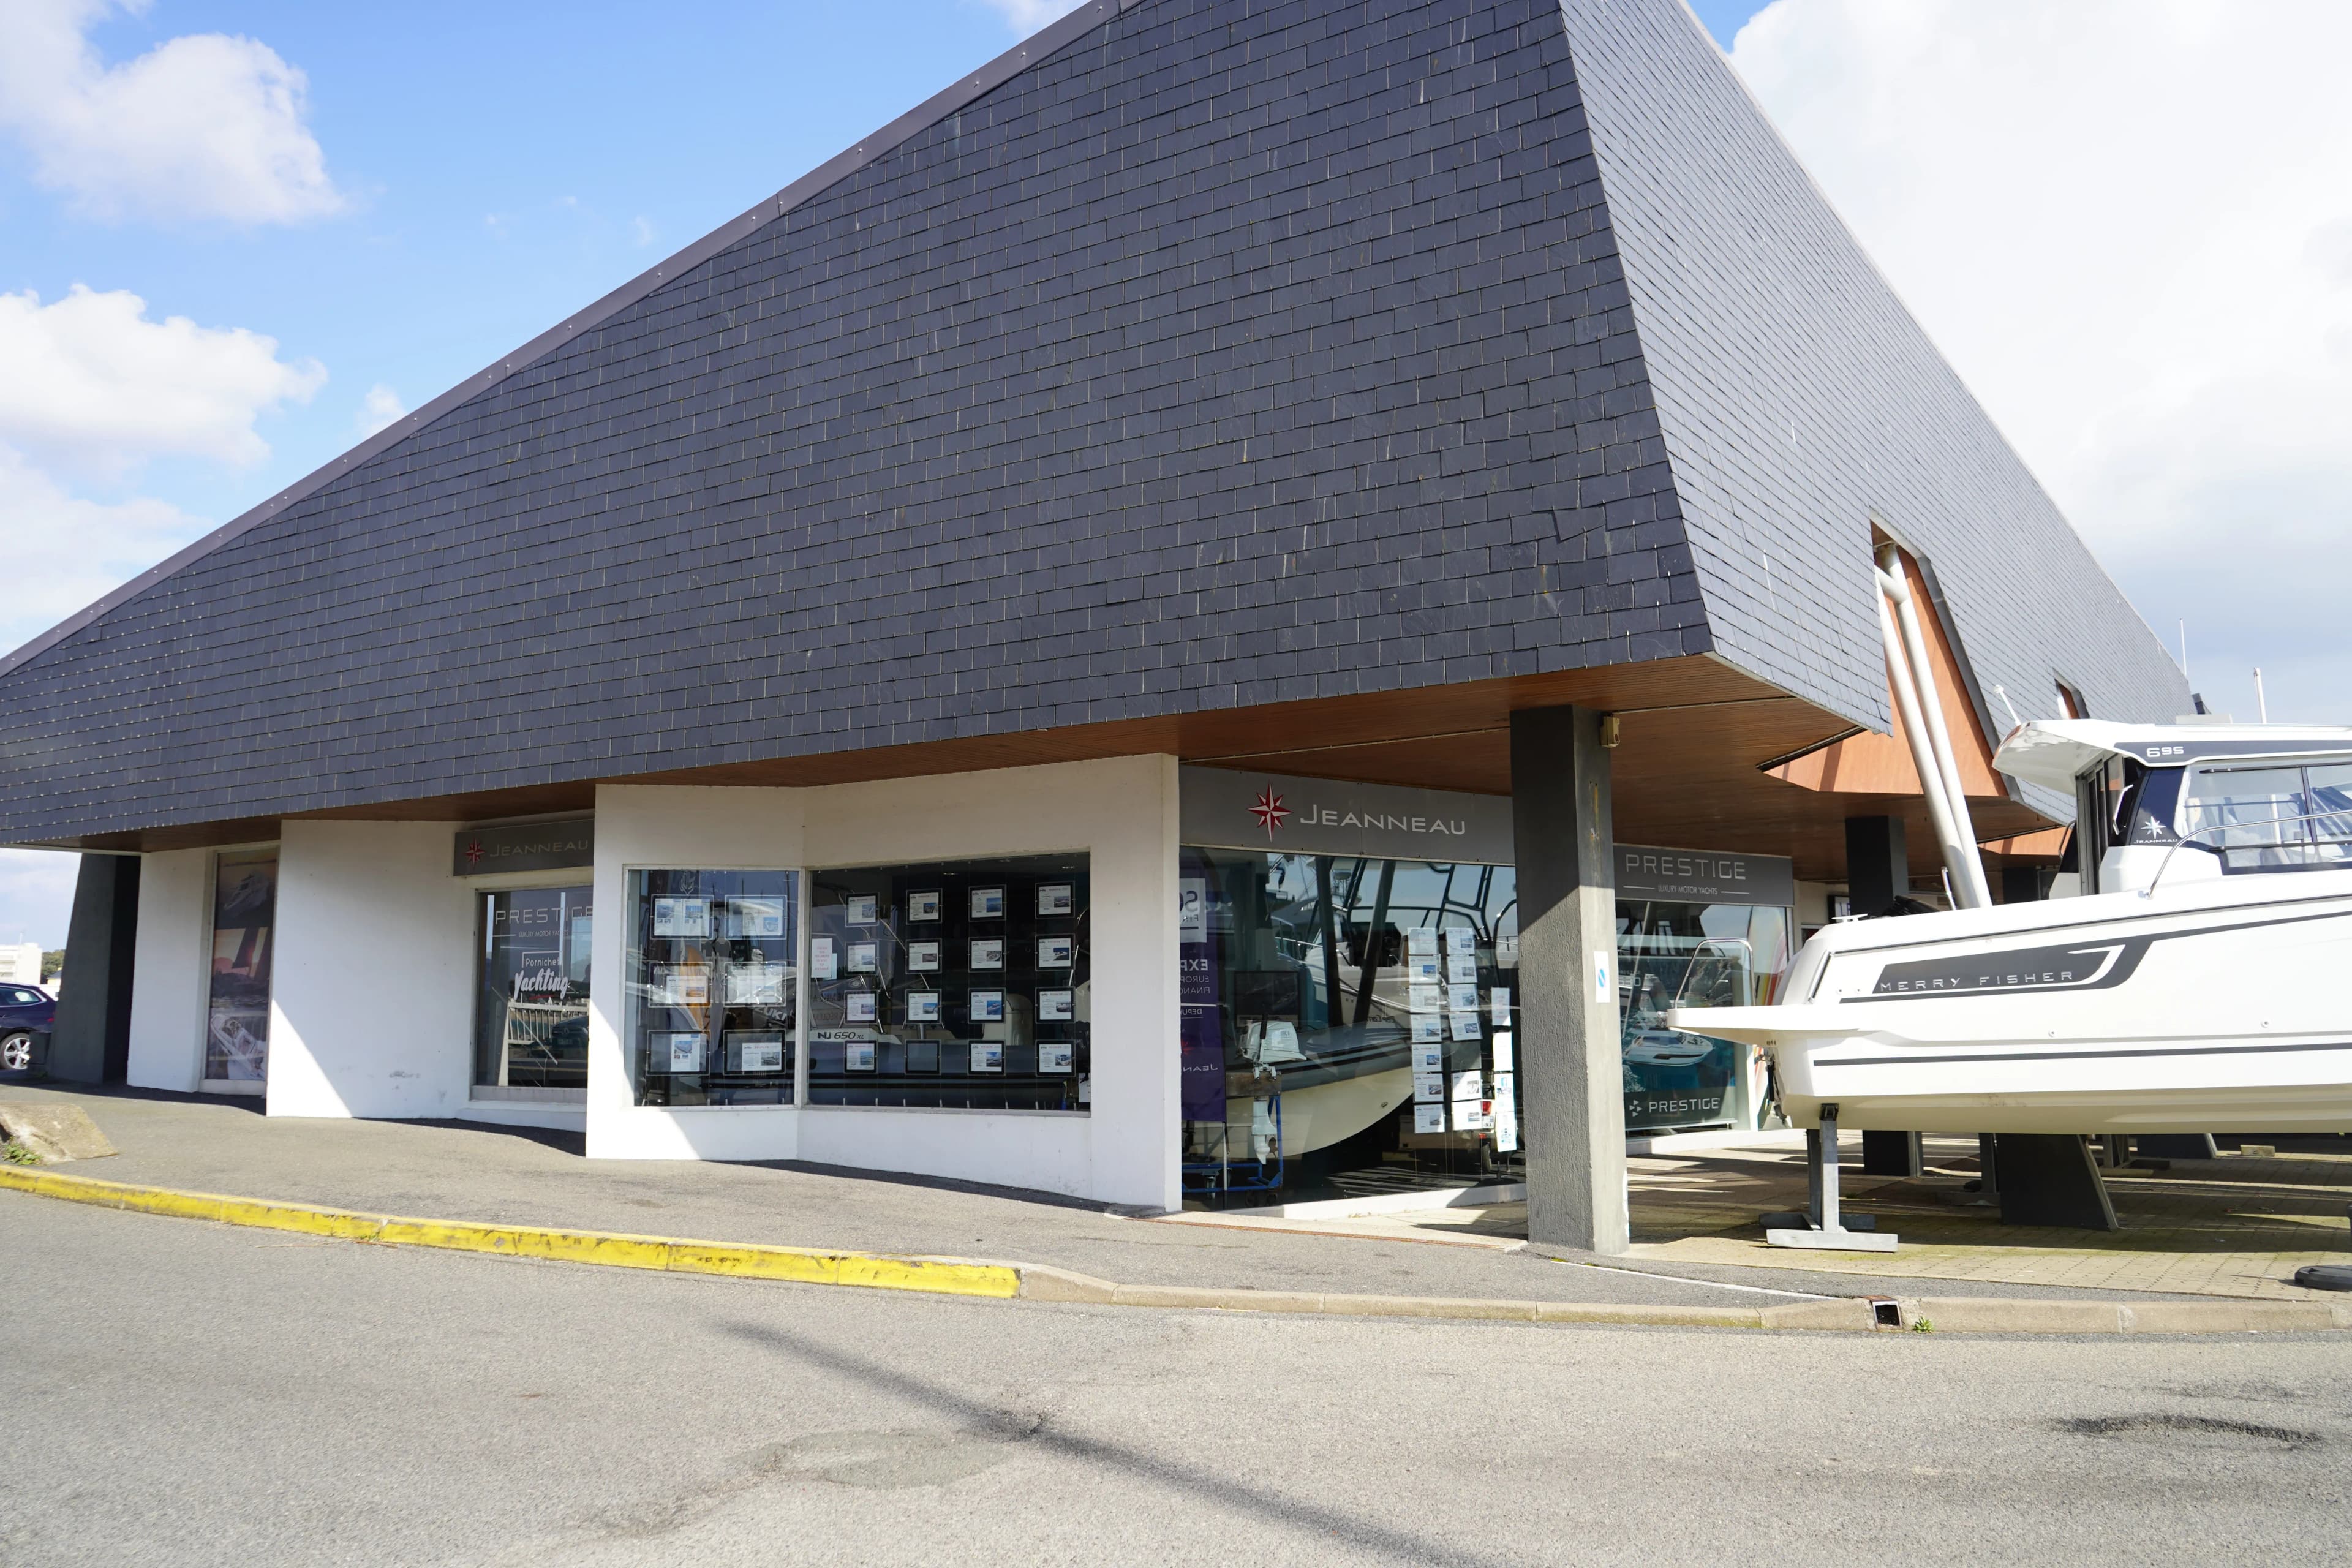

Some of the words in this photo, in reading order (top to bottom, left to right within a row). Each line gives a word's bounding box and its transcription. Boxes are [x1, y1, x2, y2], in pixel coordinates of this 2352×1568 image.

[2146, 746, 2184, 758] 695
[1300, 804, 1466, 835] JEANNEAU
[489, 840, 589, 858] JEANNEAU
[1626, 854, 1746, 880] PRESTIGE
[1678, 886, 1697, 894] MOTOR
[513, 968, 569, 1000] Yachting
[1880, 978, 1961, 992] MERRY
[1978, 971, 2073, 986] FISHER
[1649, 1098, 1720, 1113] PRESTIGE
